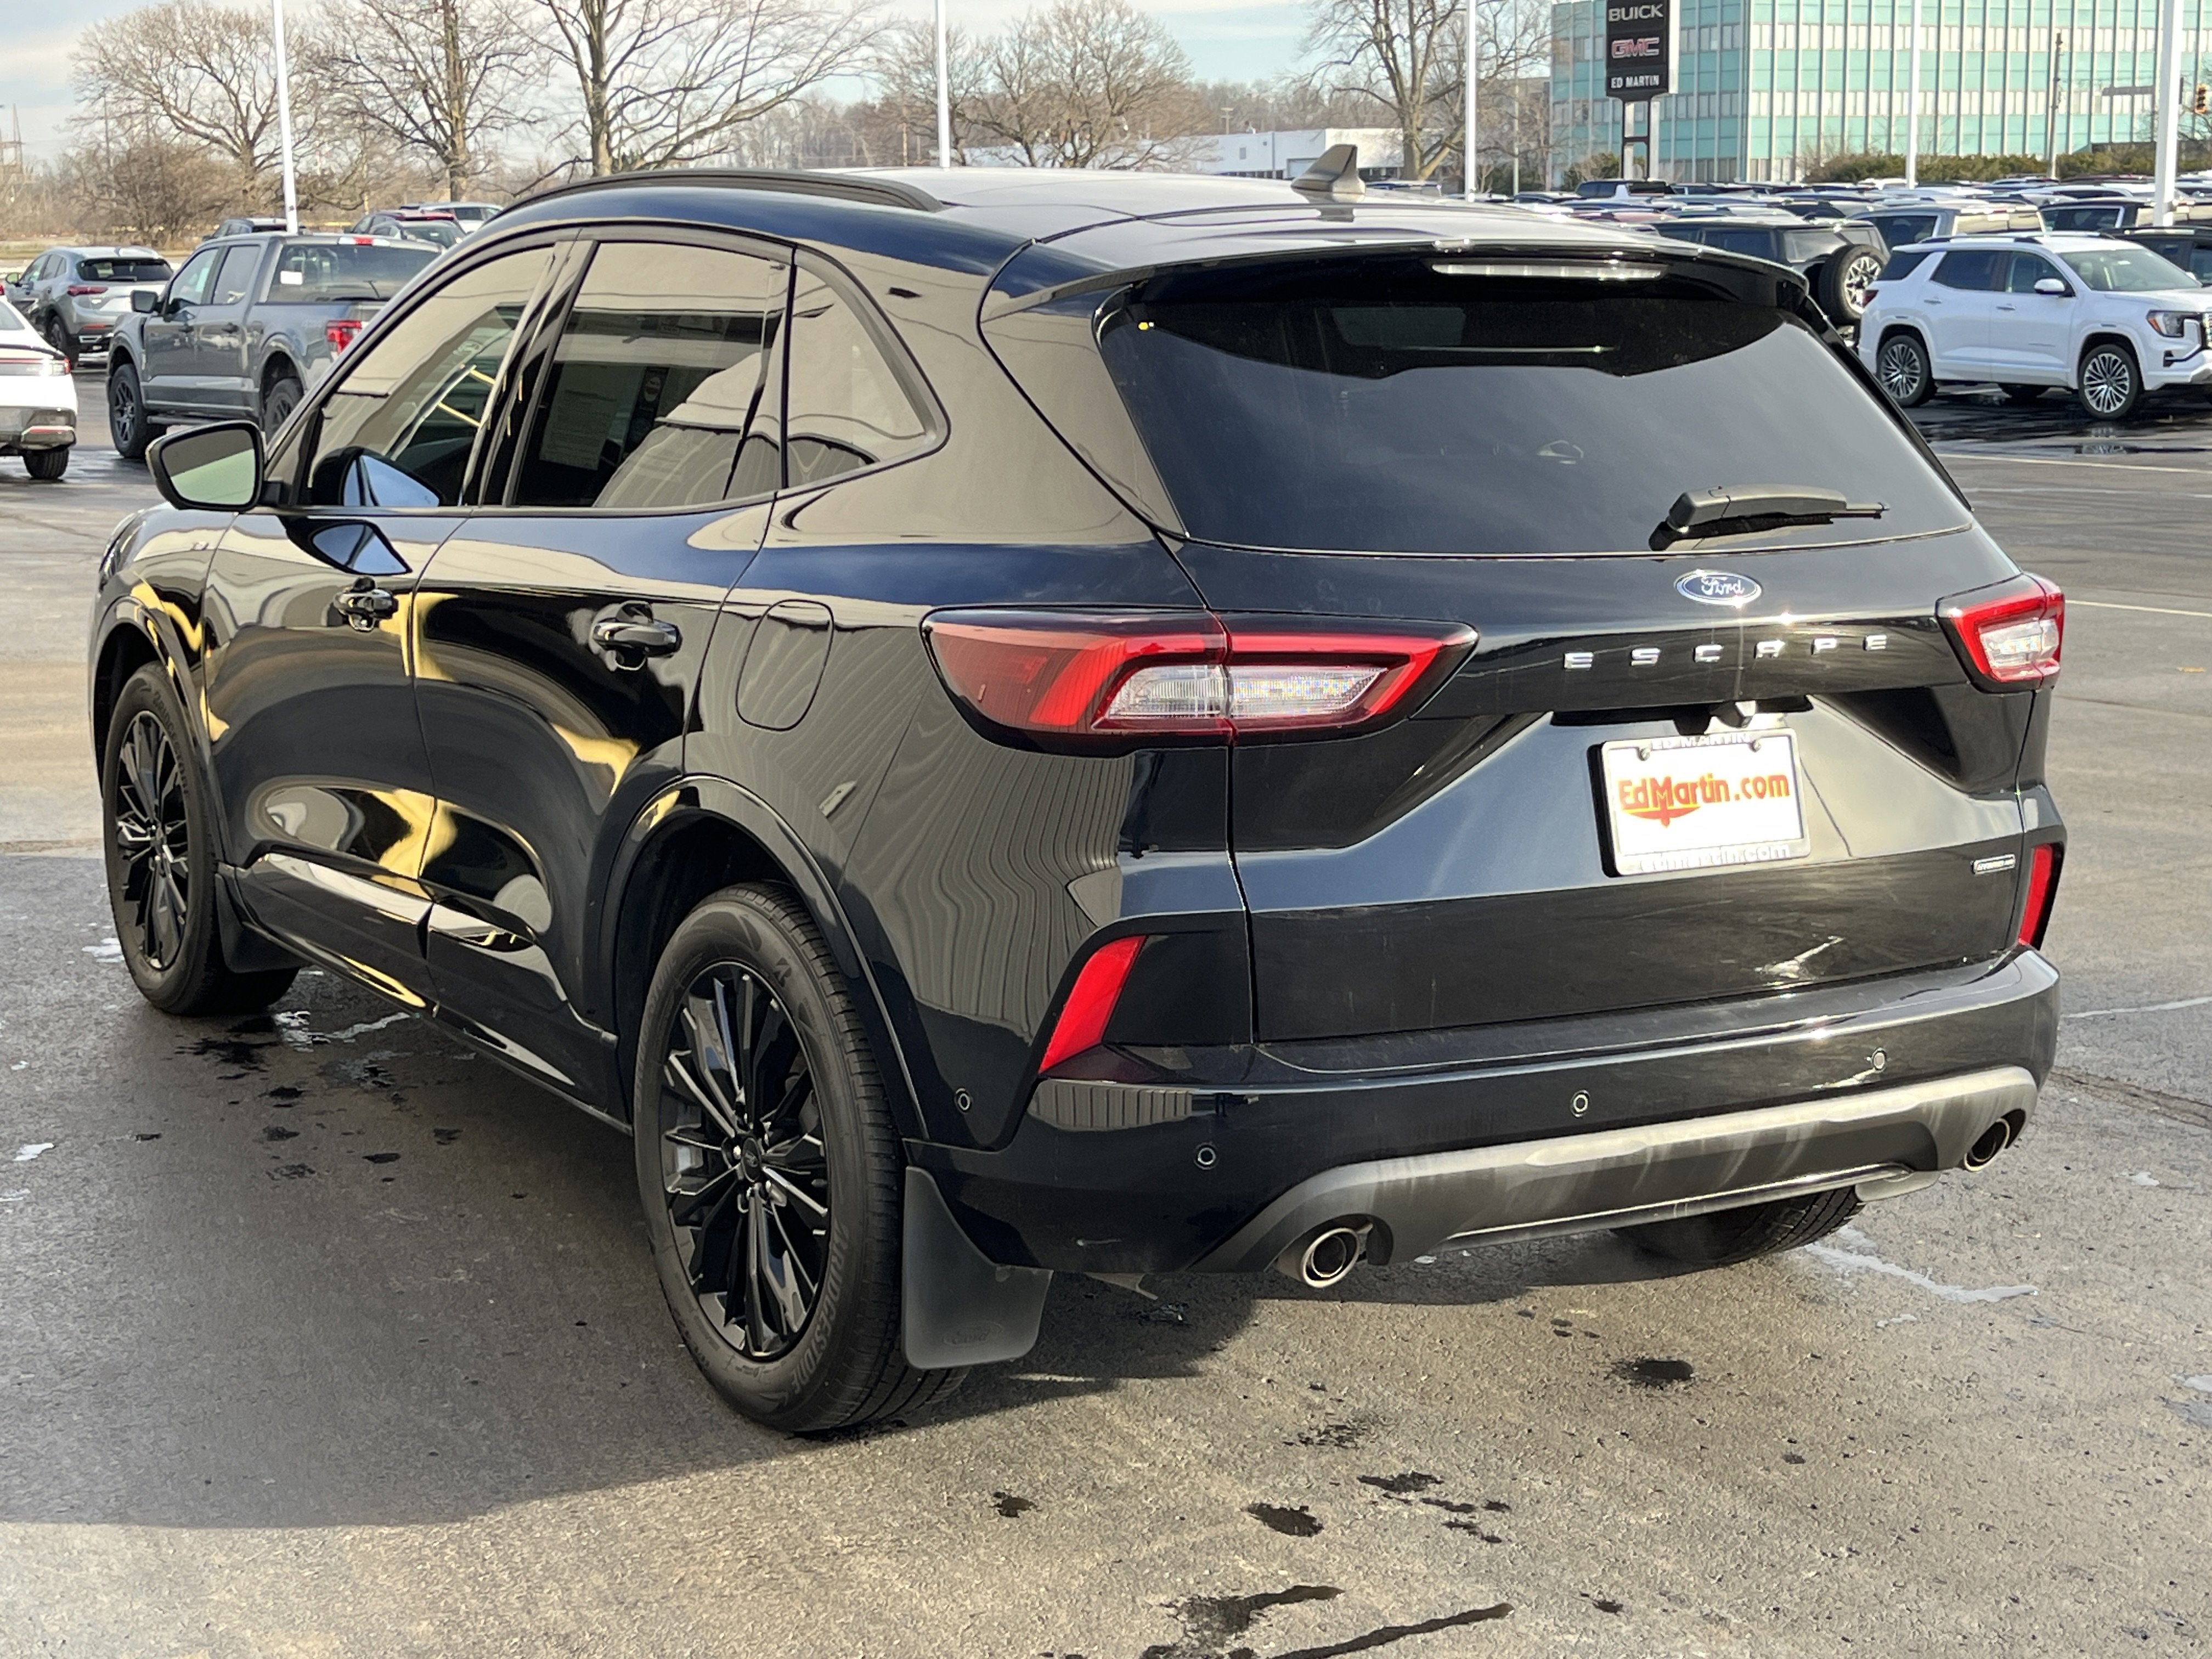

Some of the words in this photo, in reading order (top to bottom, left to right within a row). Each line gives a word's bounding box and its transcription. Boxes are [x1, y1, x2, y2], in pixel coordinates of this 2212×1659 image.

[1608, 3, 1663, 21] BUICK
[1612, 37, 1660, 59] GMC
[1611, 77, 1623, 88] ED
[1626, 75, 1660, 87] MARTIN
[1700, 576, 1745, 596] Ford
[1564, 635, 1887, 670] ESCAPE
[1651, 737, 1679, 750] ED
[1680, 732, 1751, 748] MARTIN
[1618, 772, 1790, 810] EdMartin.com
